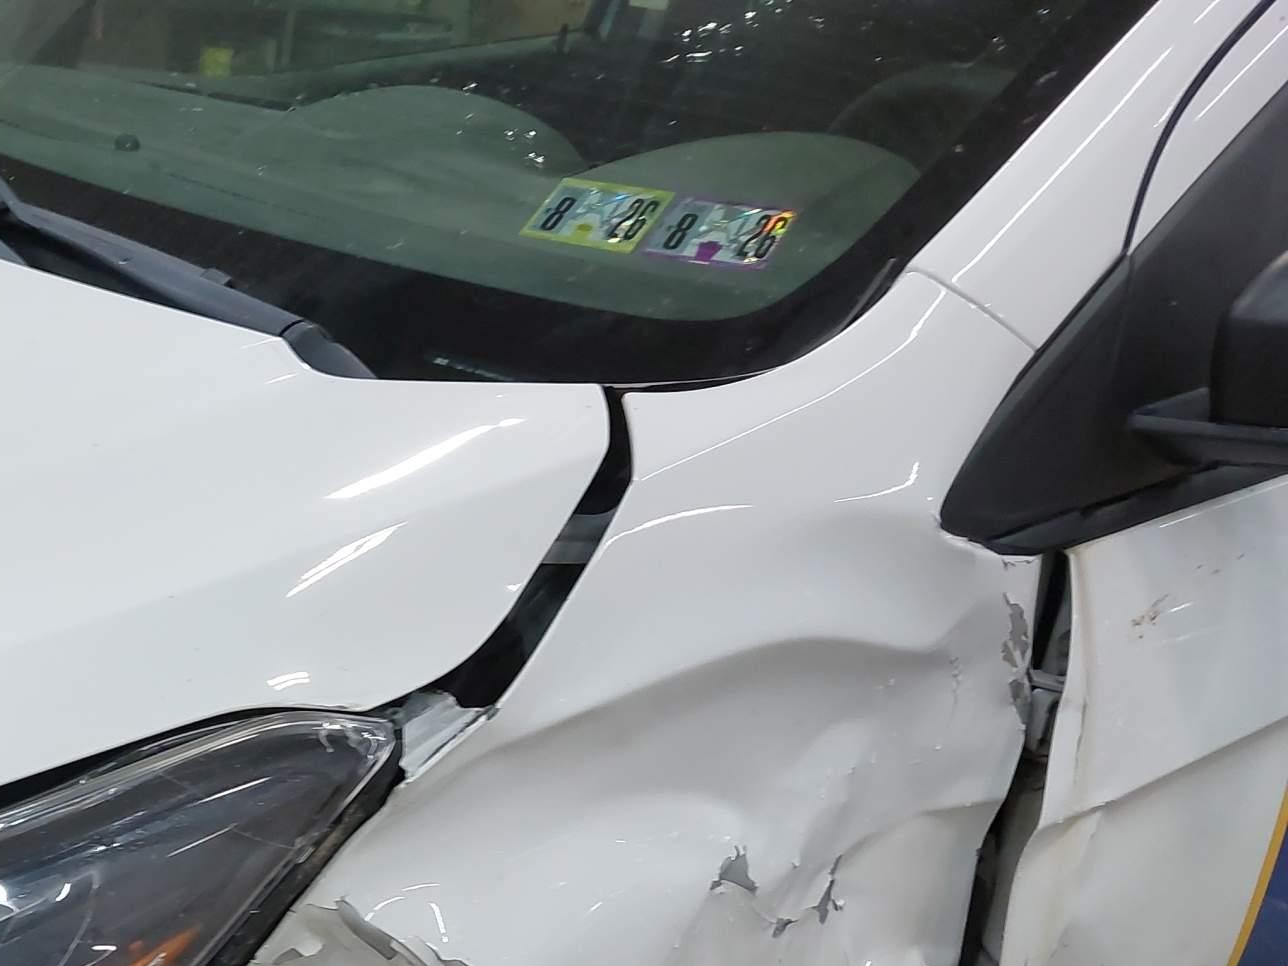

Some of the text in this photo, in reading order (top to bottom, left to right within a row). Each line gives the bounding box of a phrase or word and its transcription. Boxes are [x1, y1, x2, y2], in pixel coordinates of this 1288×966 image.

[540, 196, 660, 243] 8 26
[663, 212, 788, 261] 8 26
